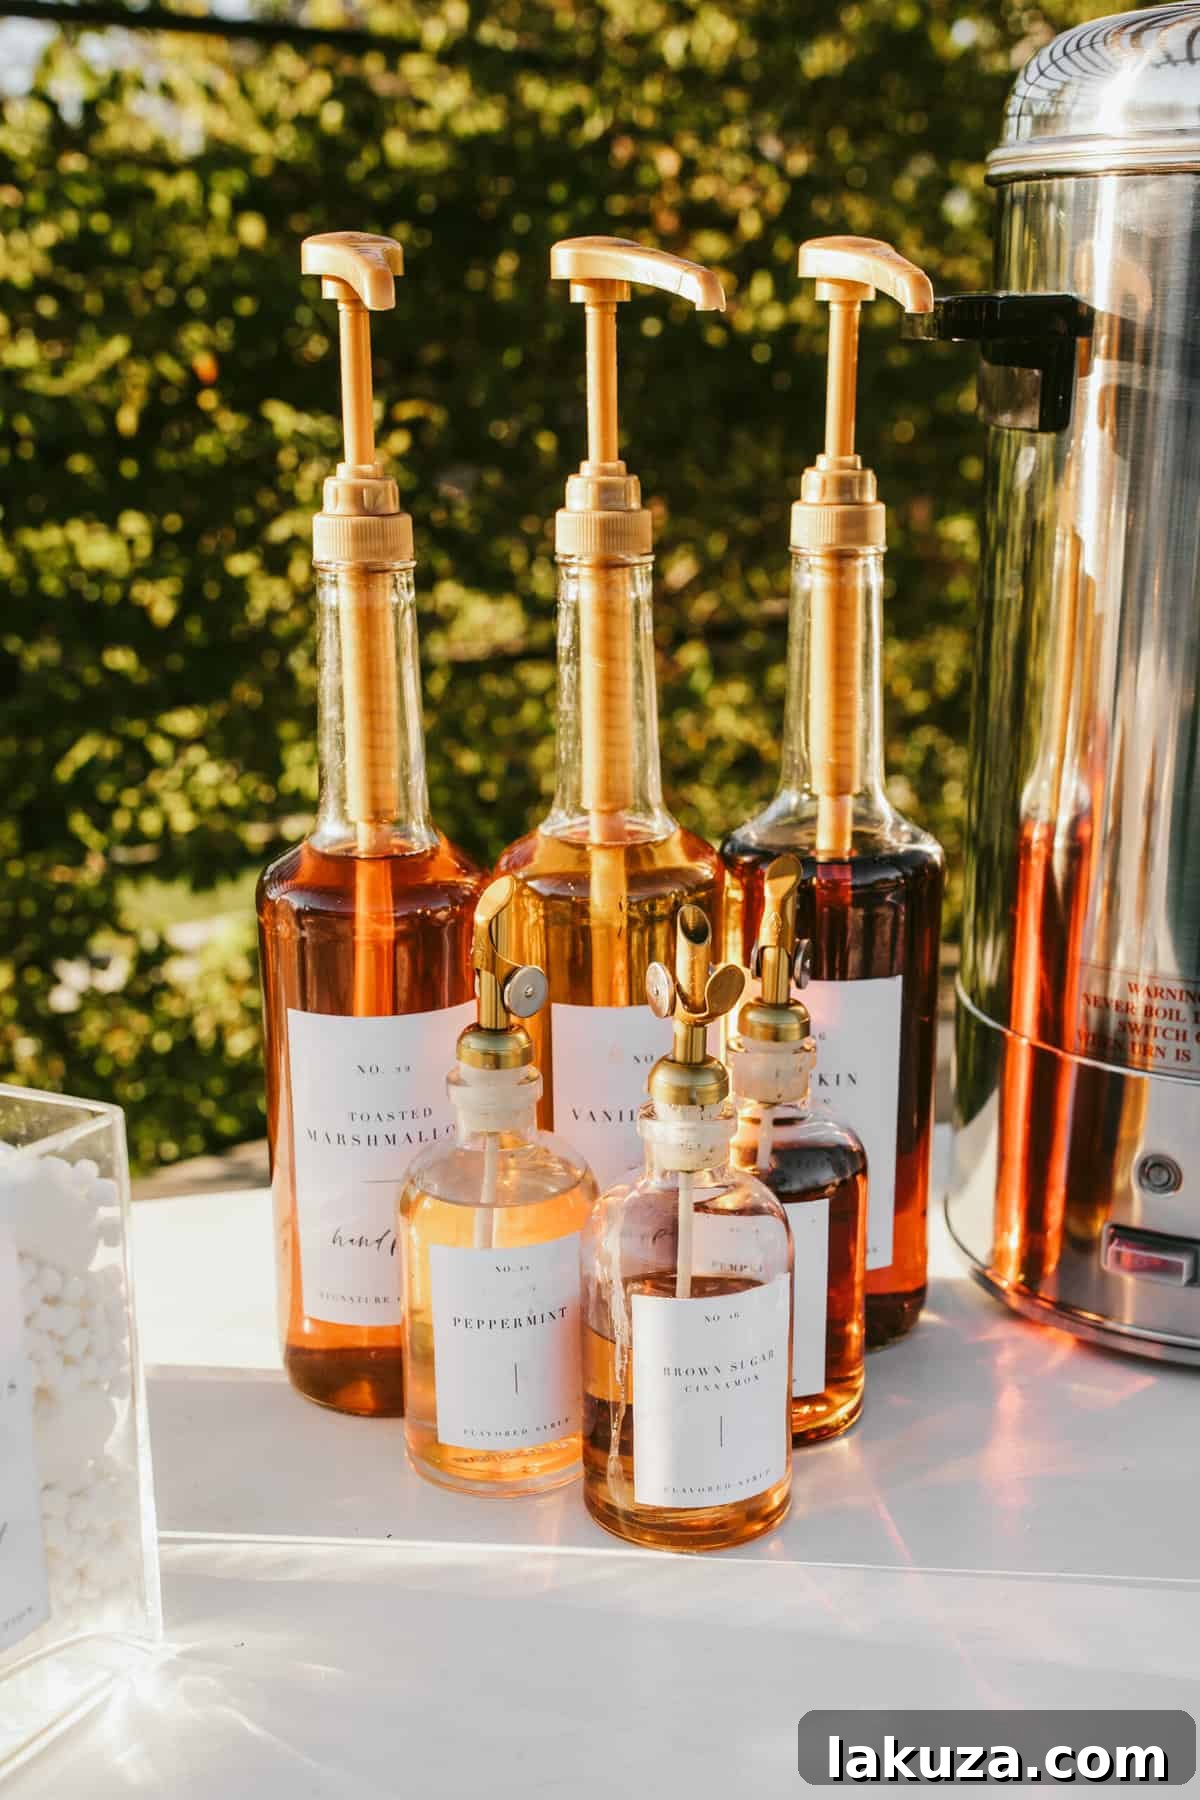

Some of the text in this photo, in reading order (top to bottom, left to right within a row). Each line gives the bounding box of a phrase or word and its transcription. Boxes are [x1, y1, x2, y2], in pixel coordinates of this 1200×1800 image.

[1082, 992, 1137, 1015] NEVER
[1175, 1048, 1192, 1063] IS
[809, 1072, 857, 1087] KIN
[348, 1107, 434, 1123] TOASTED
[305, 1123, 457, 1148] MARSHMALLO
[452, 1305, 568, 1330] PEPPERMINT
[663, 1348, 775, 1378] BROWN SUGAR
[683, 1373, 760, 1394] CINNAMON
